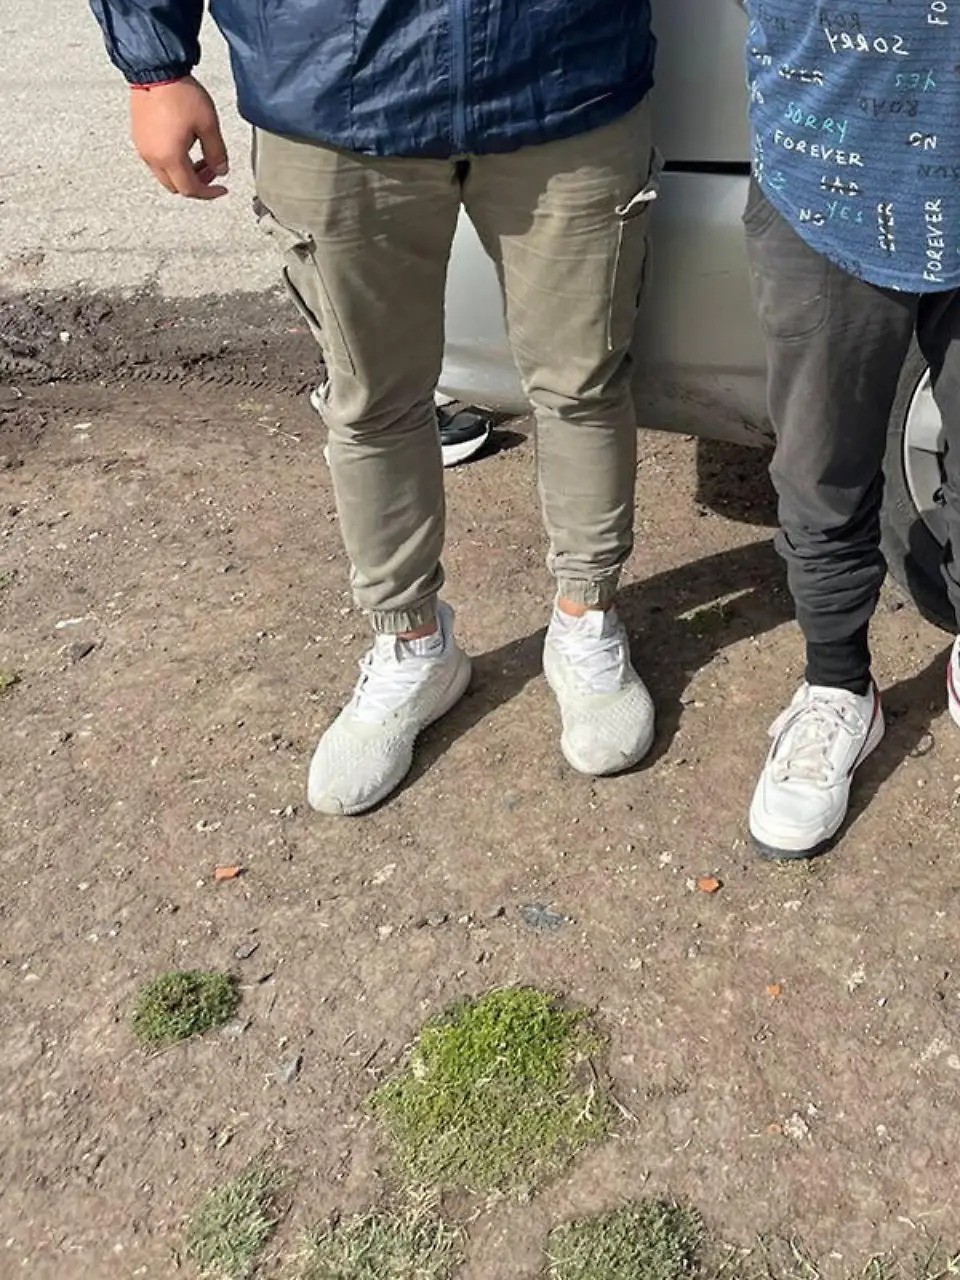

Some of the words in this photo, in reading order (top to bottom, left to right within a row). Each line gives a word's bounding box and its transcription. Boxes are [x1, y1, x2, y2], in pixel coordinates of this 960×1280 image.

[784, 103, 849, 144] SORRY
[772, 129, 864, 167] FOREVER
[798, 207, 826, 228] NO
[922, 197, 947, 283] FOREVER
